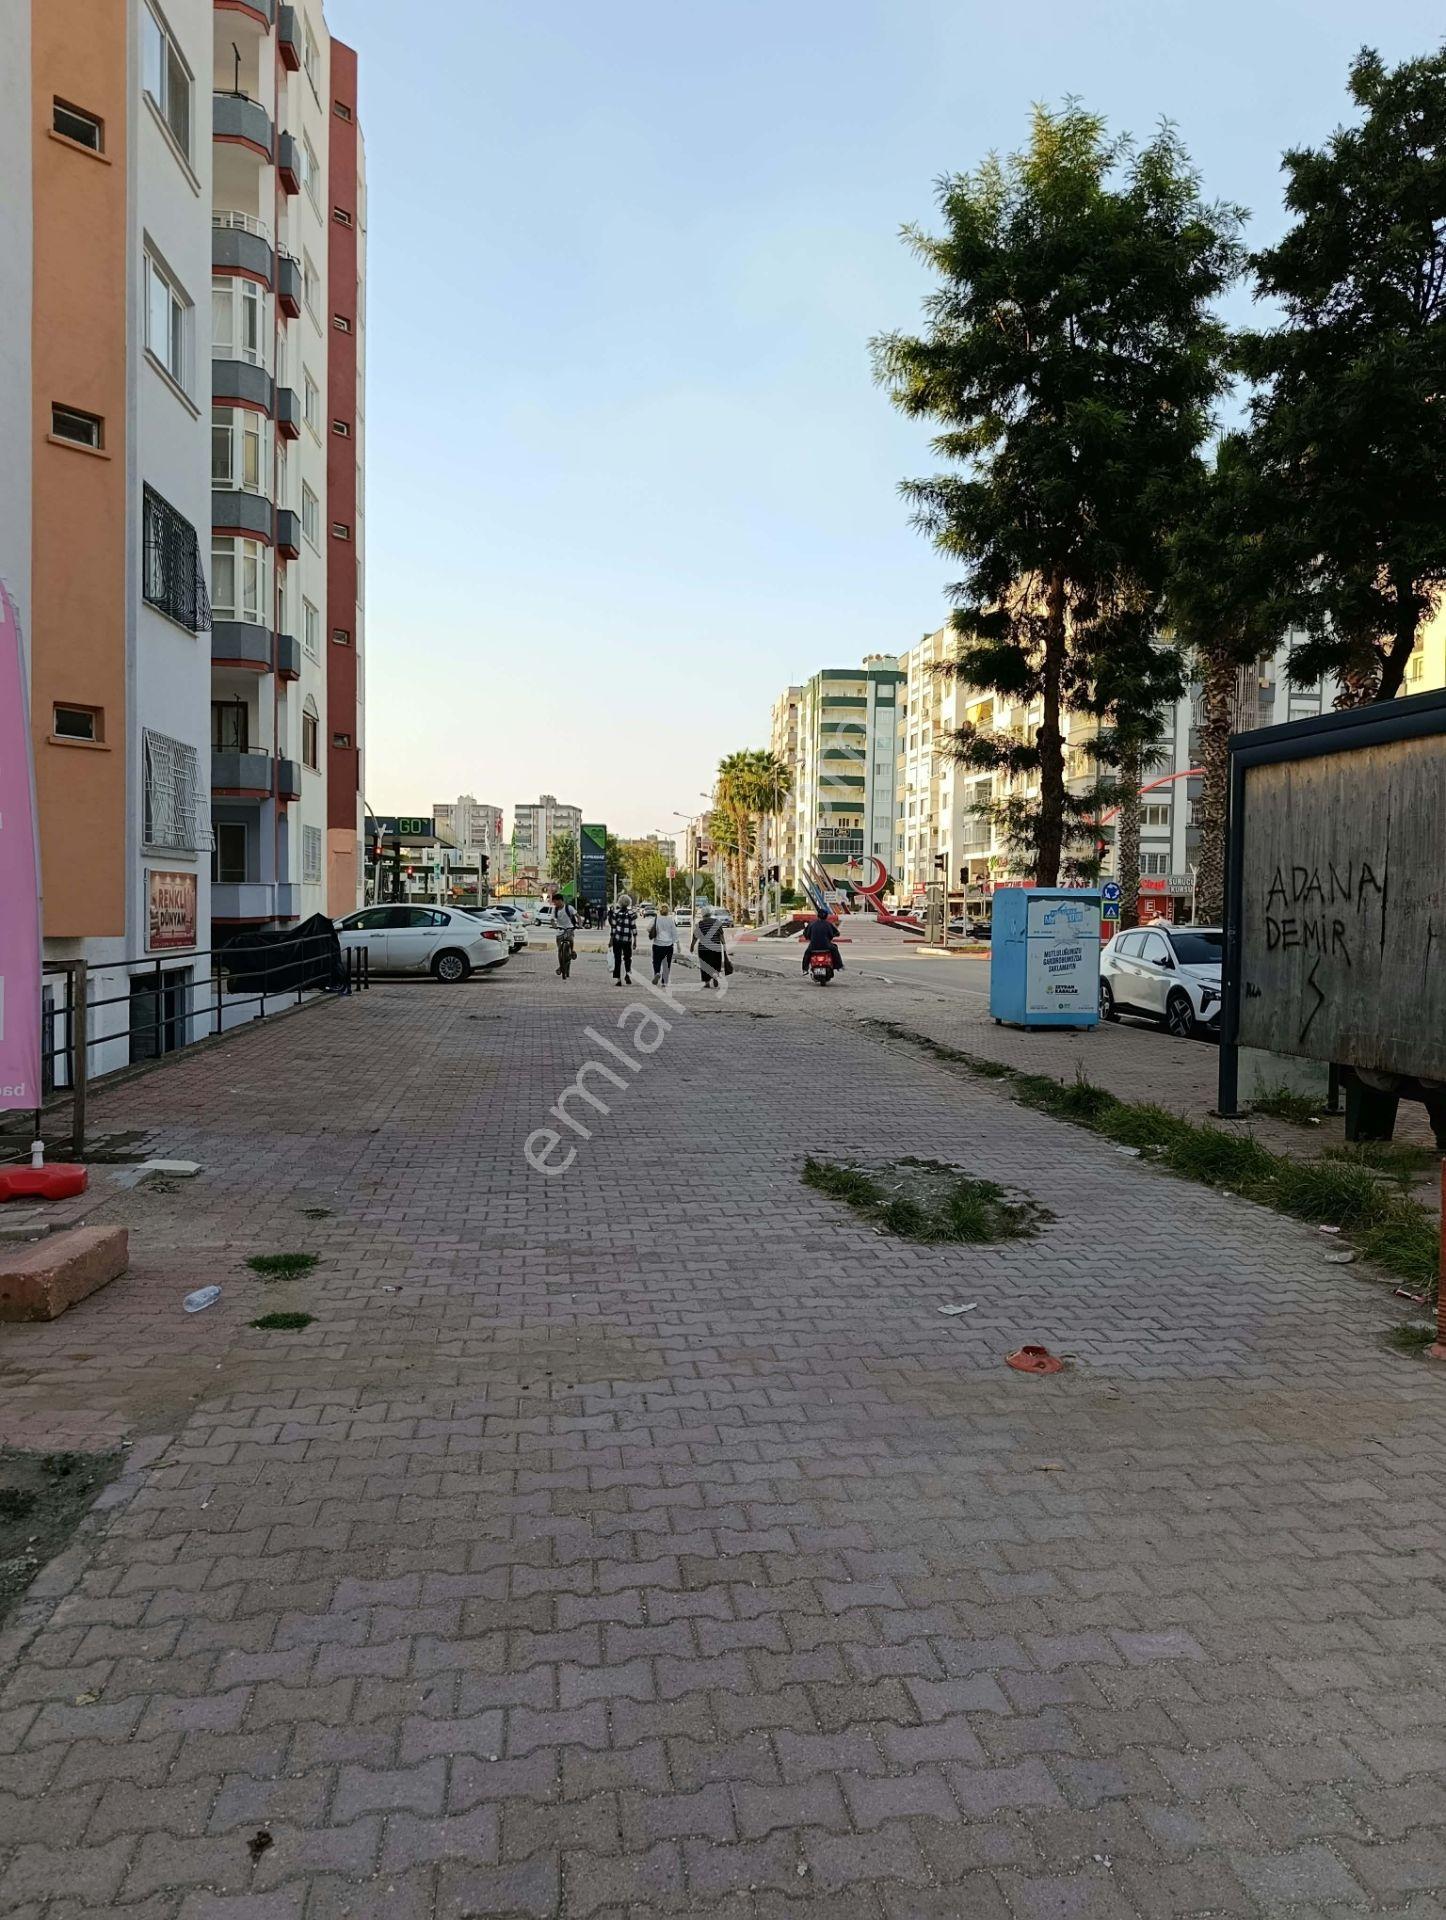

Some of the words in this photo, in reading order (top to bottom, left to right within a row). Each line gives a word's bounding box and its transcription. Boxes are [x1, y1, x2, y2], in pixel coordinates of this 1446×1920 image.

[399, 818, 422, 834] GO
[1266, 861, 1382, 914] ADANA
[1146, 901, 1154, 912] E
